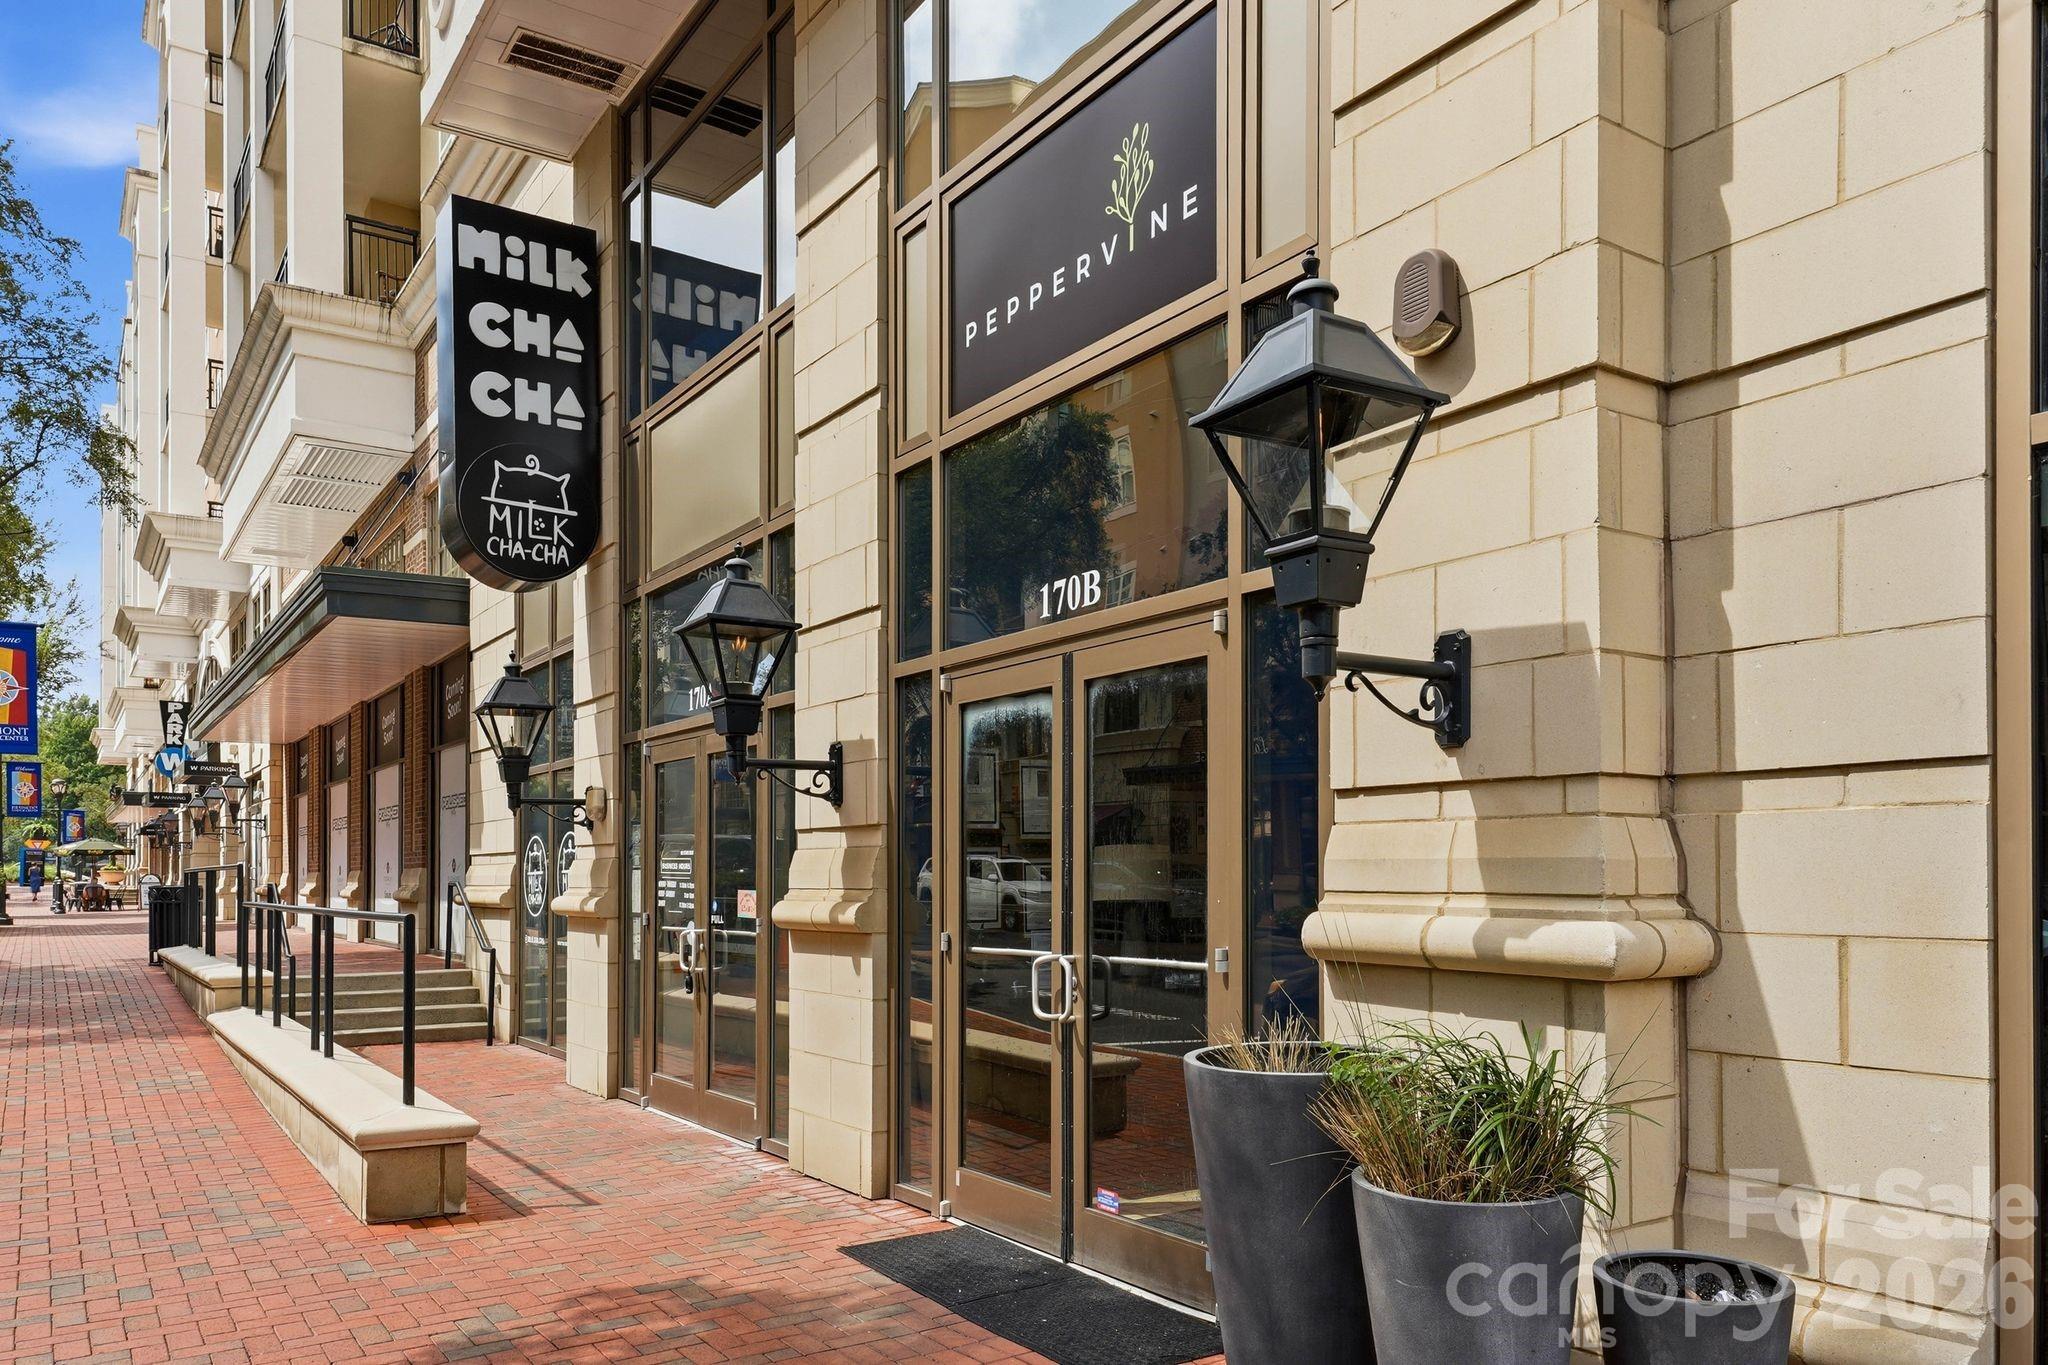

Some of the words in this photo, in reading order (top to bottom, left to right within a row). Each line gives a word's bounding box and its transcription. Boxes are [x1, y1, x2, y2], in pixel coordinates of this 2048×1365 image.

[965, 184, 1198, 348] PEPPERVINE
[468, 301, 584, 363] CHA
[470, 371, 585, 431] CHA
[489, 500, 574, 547] MILK
[486, 536, 570, 567] CHA-CHA
[1040, 569, 1101, 619] 170B
[166, 702, 184, 745] PARK
[710, 915, 724, 924] PULL
